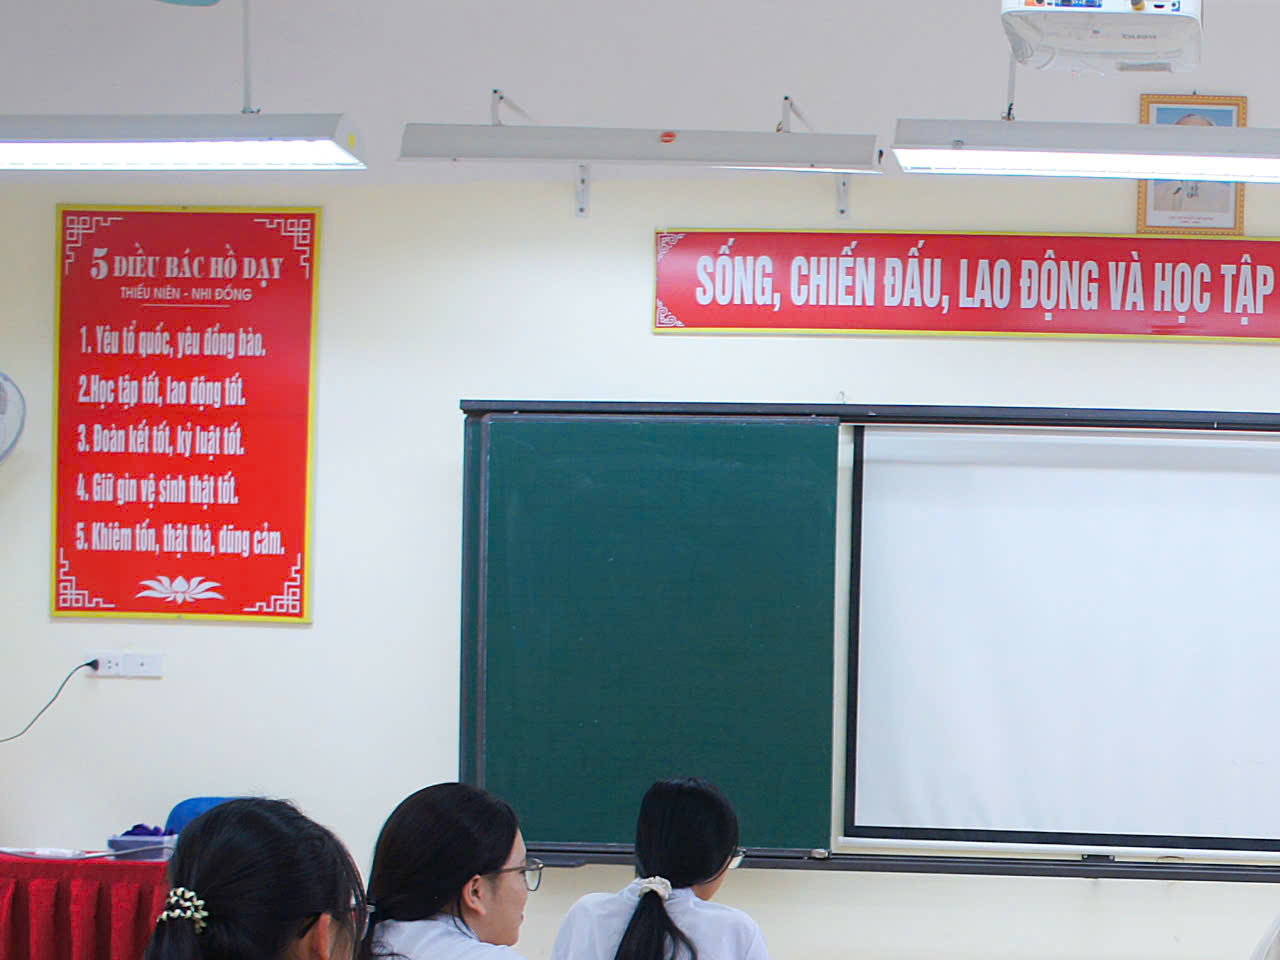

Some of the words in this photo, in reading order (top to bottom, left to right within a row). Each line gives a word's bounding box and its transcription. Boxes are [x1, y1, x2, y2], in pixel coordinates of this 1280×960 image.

[90, 248, 108, 280] 5
[113, 242, 159, 277] ĐIỀU
[165, 248, 205, 278] BÁC
[210, 243, 237, 278] HỒ
[242, 257, 284, 287] DẠY
[695, 238, 781, 312] SỐNG,
[791, 241, 875, 306] CHIẾN
[884, 240, 949, 314] ĐẤU,
[959, 259, 1010, 308] LAO
[1020, 249, 1099, 321] ĐỘNG
[1108, 251, 1145, 311] VÀ
[1154, 262, 1211, 324] HỌC
[1221, 254, 1274, 325] TẬP
[154, 285, 180, 299] NIÊN
[192, 288, 211, 299] NHI
[80, 326, 92, 352] 1.
[96, 325, 119, 353] Yêu
[139, 322, 174, 357] quốc,
[178, 327, 200, 358] yêu
[119, 375, 138, 409] tập
[142, 371, 162, 407] tốt,
[167, 376, 187, 405] lao
[191, 376, 222, 410] động
[225, 372, 246, 405] tốt.
[77, 424, 89, 452] 3.
[93, 424, 125, 453] Đoàn
[129, 419, 149, 453] kết
[153, 420, 173, 456] tốt,
[196, 426, 221, 461] luật
[224, 422, 245, 455] tốt.
[76, 473, 89, 501] 4.
[93, 473, 114, 502] Giữ
[141, 474, 155, 508] vệ
[159, 475, 185, 503] sinh
[190, 475, 214, 510] thật
[218, 471, 239, 504] tốt.
[76, 522, 88, 550] 5.
[92, 522, 131, 551] Khiêm
[135, 518, 159, 555] tốn,
[163, 524, 188, 558] thật
[192, 524, 215, 556] thà,
[220, 524, 250, 557] dũng
[254, 522, 285, 555] cảm.
